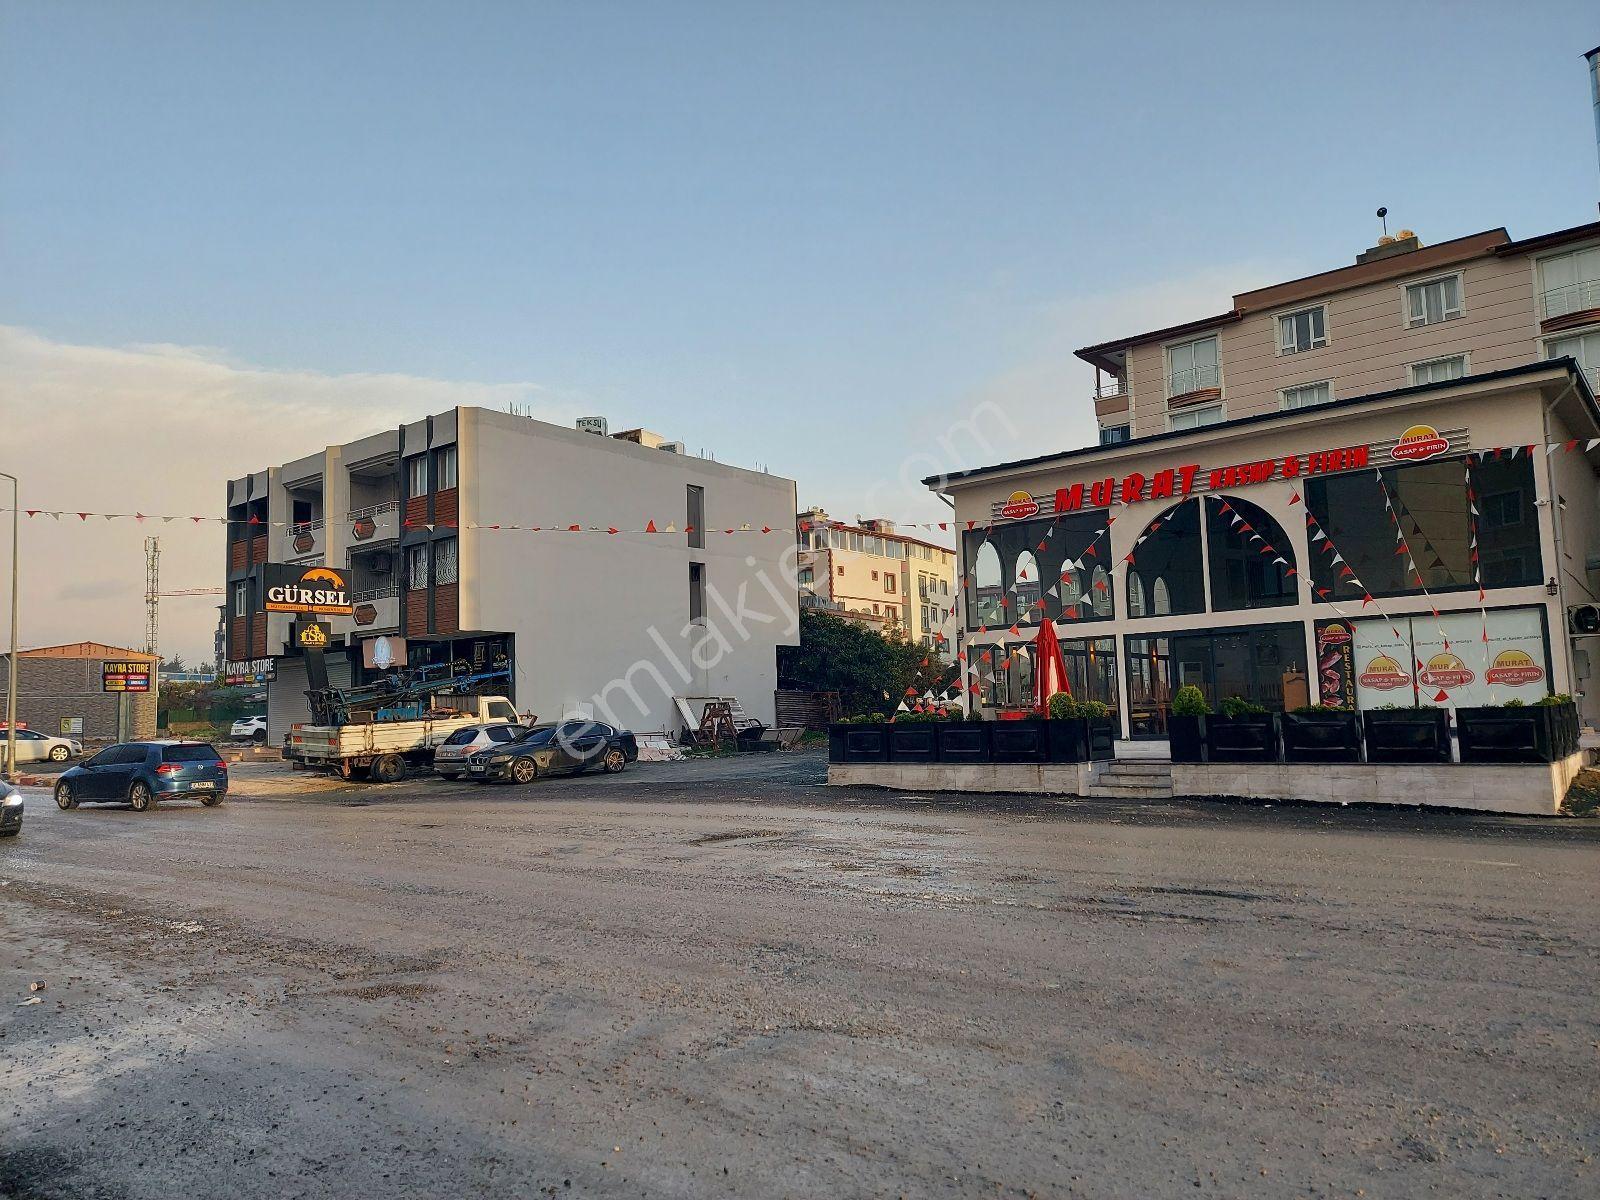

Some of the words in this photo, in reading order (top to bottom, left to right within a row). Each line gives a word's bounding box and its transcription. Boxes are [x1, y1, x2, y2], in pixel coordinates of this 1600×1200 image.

[1402, 433, 1434, 444] MURAT
[1393, 447, 1417, 457] KASAP
[1054, 465, 1200, 512] MURAT
[1209, 459, 1276, 490] KASAP
[1282, 455, 1300, 478] &
[1307, 444, 1370, 475] FIRIN
[268, 584, 350, 606] GÜRSEL
[104, 663, 127, 673] KAYRA
[127, 663, 150, 673] STORE
[225, 661, 249, 676] KAYRA
[251, 658, 275, 673] STORE
[1496, 659, 1529, 667] MURAT
